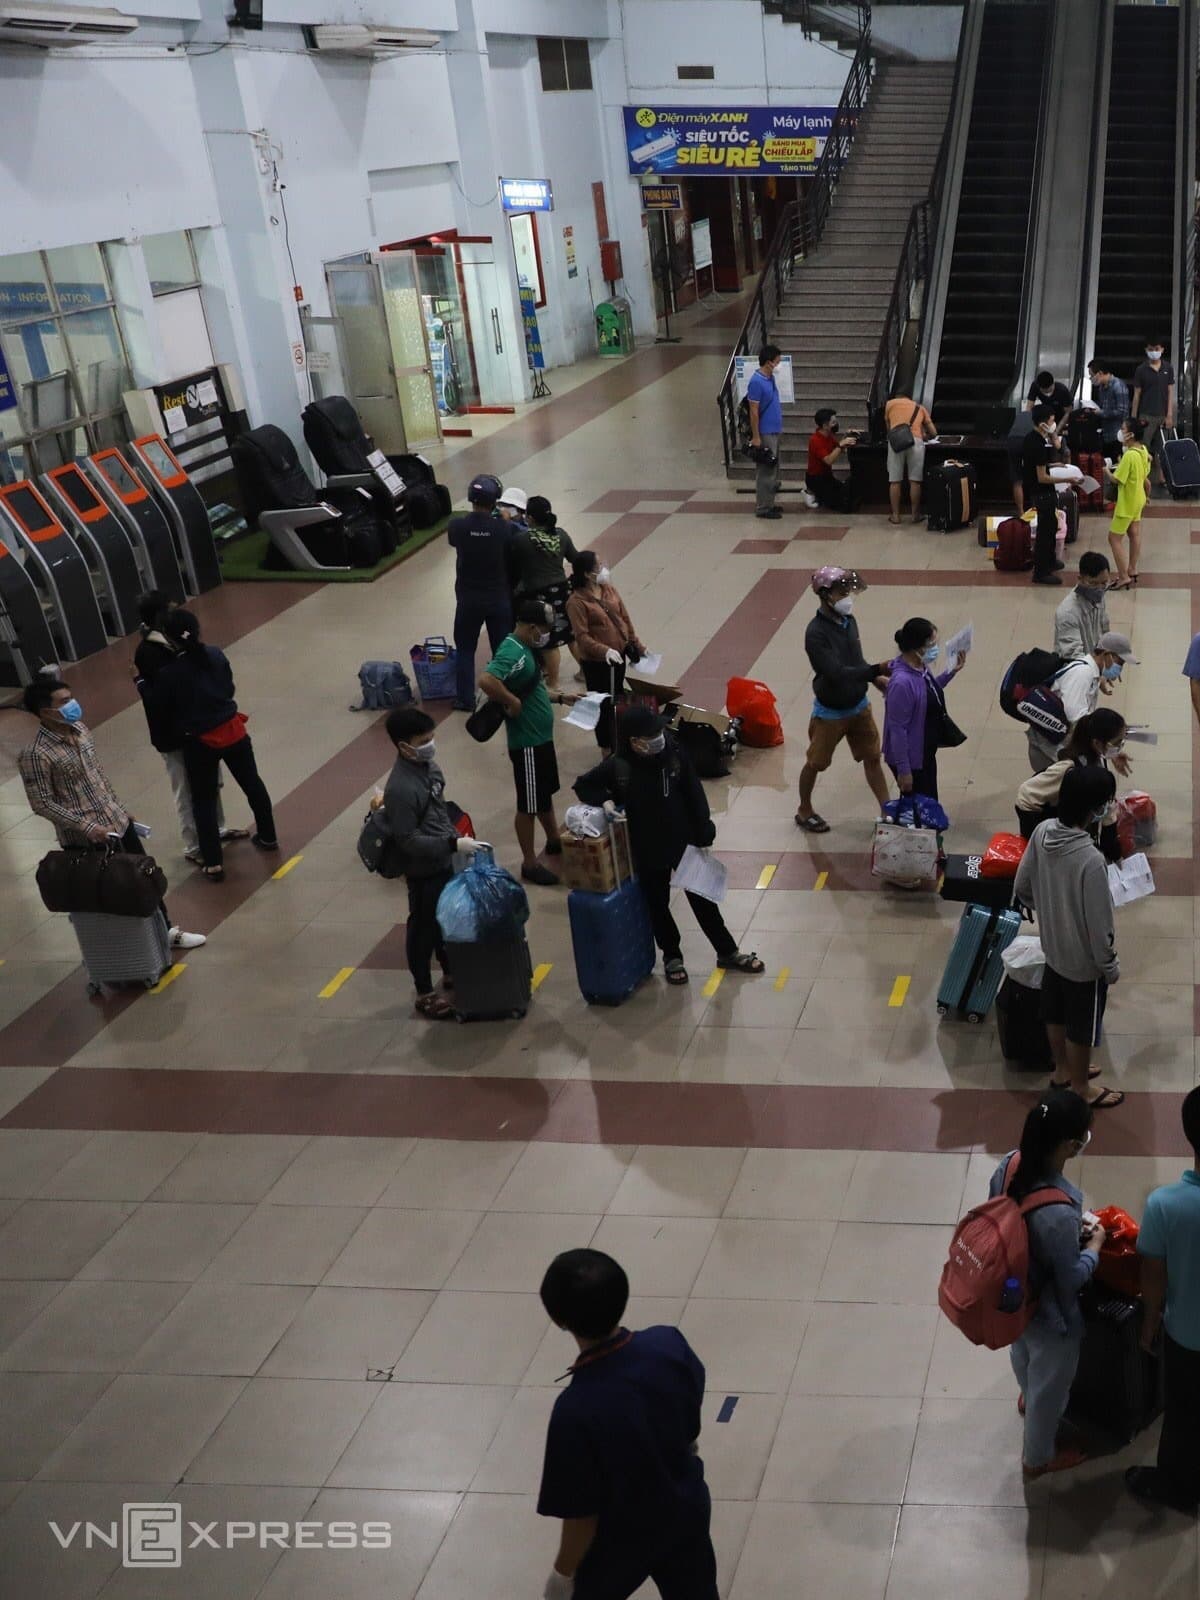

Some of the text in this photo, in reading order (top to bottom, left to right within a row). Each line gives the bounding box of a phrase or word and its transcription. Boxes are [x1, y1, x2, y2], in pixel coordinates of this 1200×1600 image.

[659, 113, 748, 124] Điện máy XANH
[773, 115, 832, 130] Máy lạnh
[685, 125, 750, 143] SIÊU TỐC
[676, 140, 761, 168] SIÊU RẺ
[18, 292, 91, 303] INFORATION
[163, 392, 186, 410] Rest
[1020, 703, 1065, 731] UNBEATABLE
